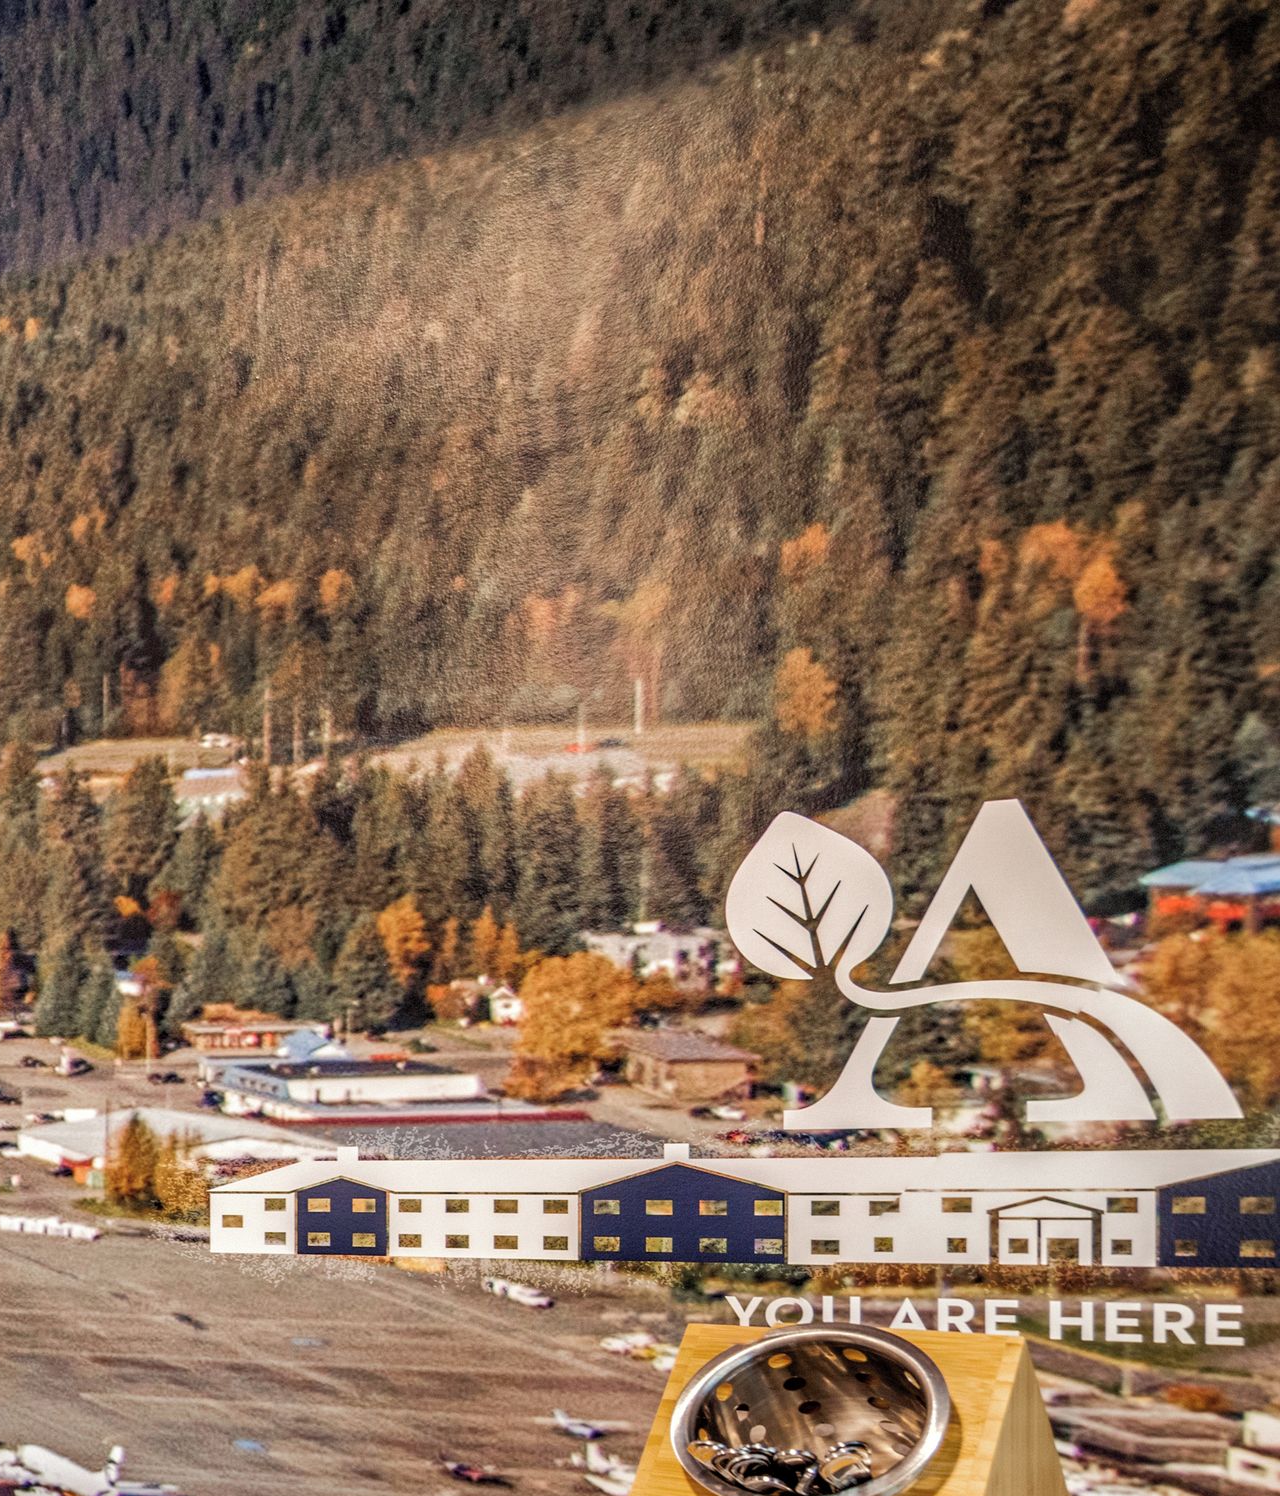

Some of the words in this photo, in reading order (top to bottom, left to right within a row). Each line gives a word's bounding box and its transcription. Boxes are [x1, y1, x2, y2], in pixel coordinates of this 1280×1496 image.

[724, 1295, 862, 1328] YOU
[888, 1297, 1020, 1337] ARE
[1048, 1300, 1246, 1347] HERE
